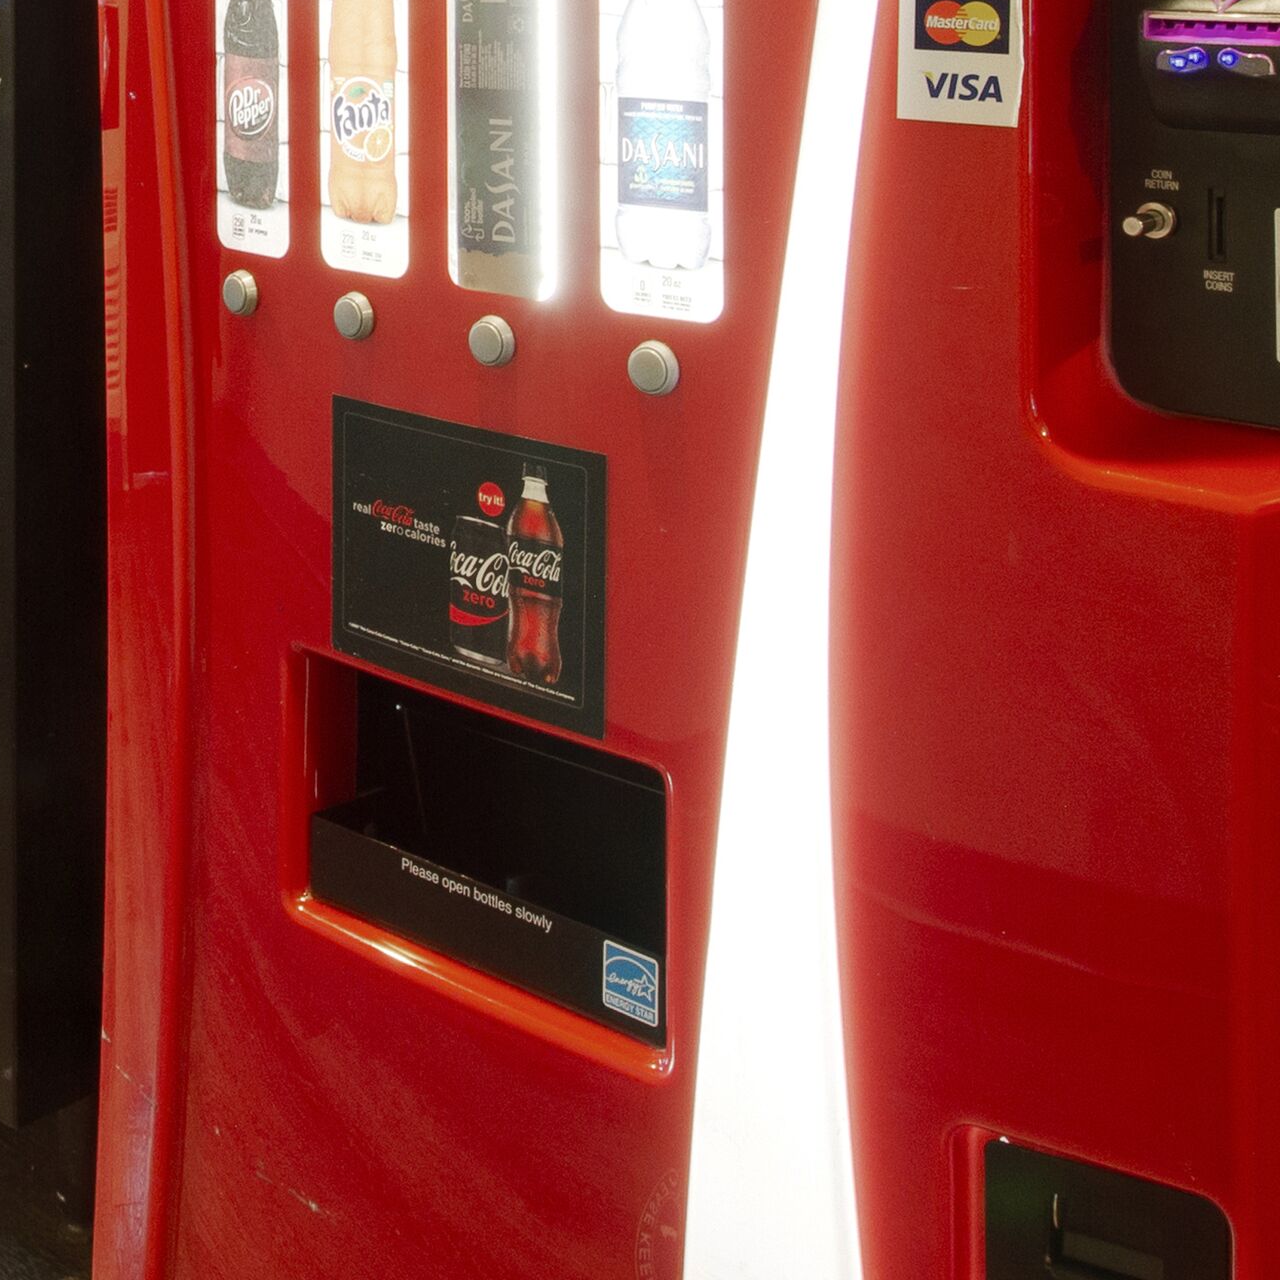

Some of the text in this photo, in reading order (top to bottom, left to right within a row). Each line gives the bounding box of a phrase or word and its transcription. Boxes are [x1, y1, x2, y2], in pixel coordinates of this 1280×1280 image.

[925, 12, 1001, 34] MasterCard
[243, 86, 261, 104] Dr
[924, 71, 1003, 103] VISA
[232, 89, 271, 130] Pepper
[622, 133, 704, 173] DASANI
[489, 116, 521, 243] DASANI
[1145, 179, 1180, 191] RETURN
[1151, 169, 1172, 180] COIN
[1203, 270, 1235, 282] INSERT
[1205, 281, 1233, 293] COINS
[479, 492, 492, 506] try
[353, 499, 440, 534] real Coca-Cola taste
[380, 521, 446, 548] zero calories
[523, 574, 545, 588] zero
[463, 589, 495, 608] zero
[401, 857, 552, 933] Please open bottles slowly
[606, 994, 654, 1021] ENERGY STAR
